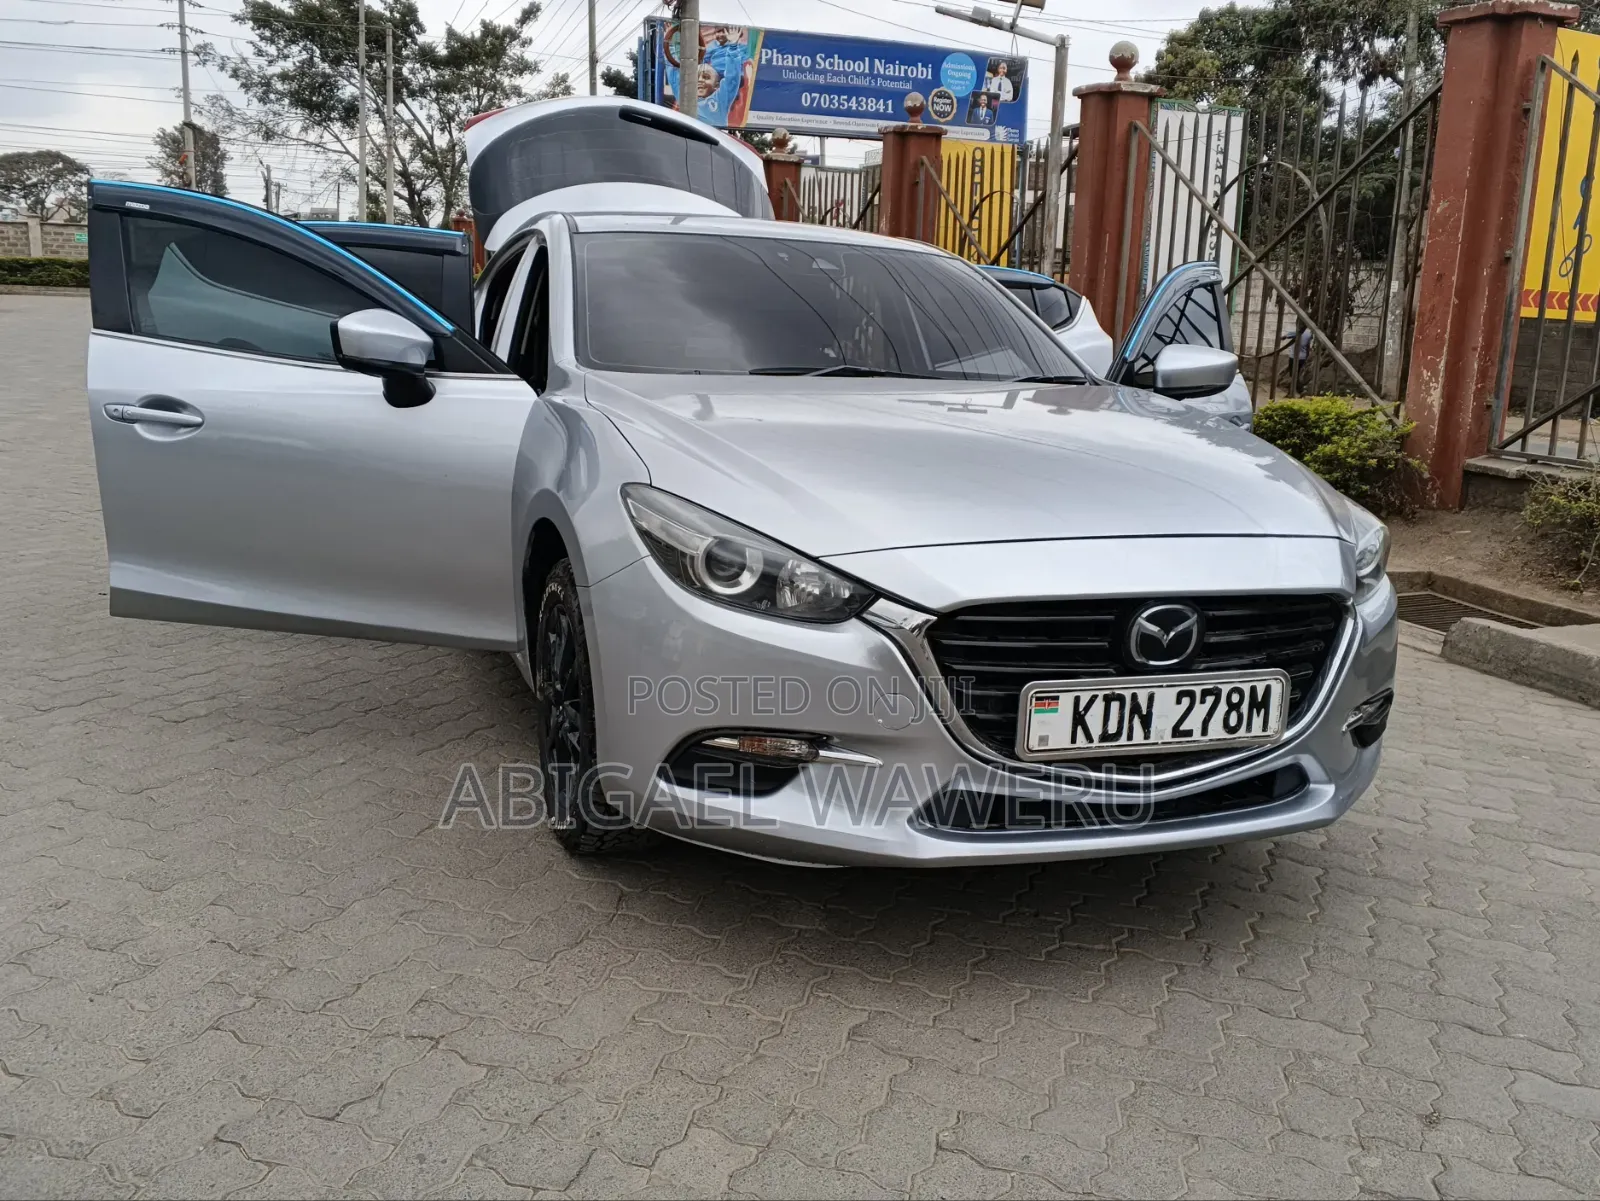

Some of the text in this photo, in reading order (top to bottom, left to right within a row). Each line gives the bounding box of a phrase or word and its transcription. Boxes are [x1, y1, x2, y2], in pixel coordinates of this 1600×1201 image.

[761, 48, 933, 80] Pharo School Nairobi
[942, 62, 975, 71] Admissions
[782, 70, 913, 90] Unlocking Each Child's Potential
[947, 69, 971, 79] Ongoing
[801, 92, 894, 114] 0703543841
[933, 96, 952, 104] Register
[933, 103, 952, 112] NOW
[1070, 691, 1155, 745] KDN
[1171, 684, 1272, 739] 278M
